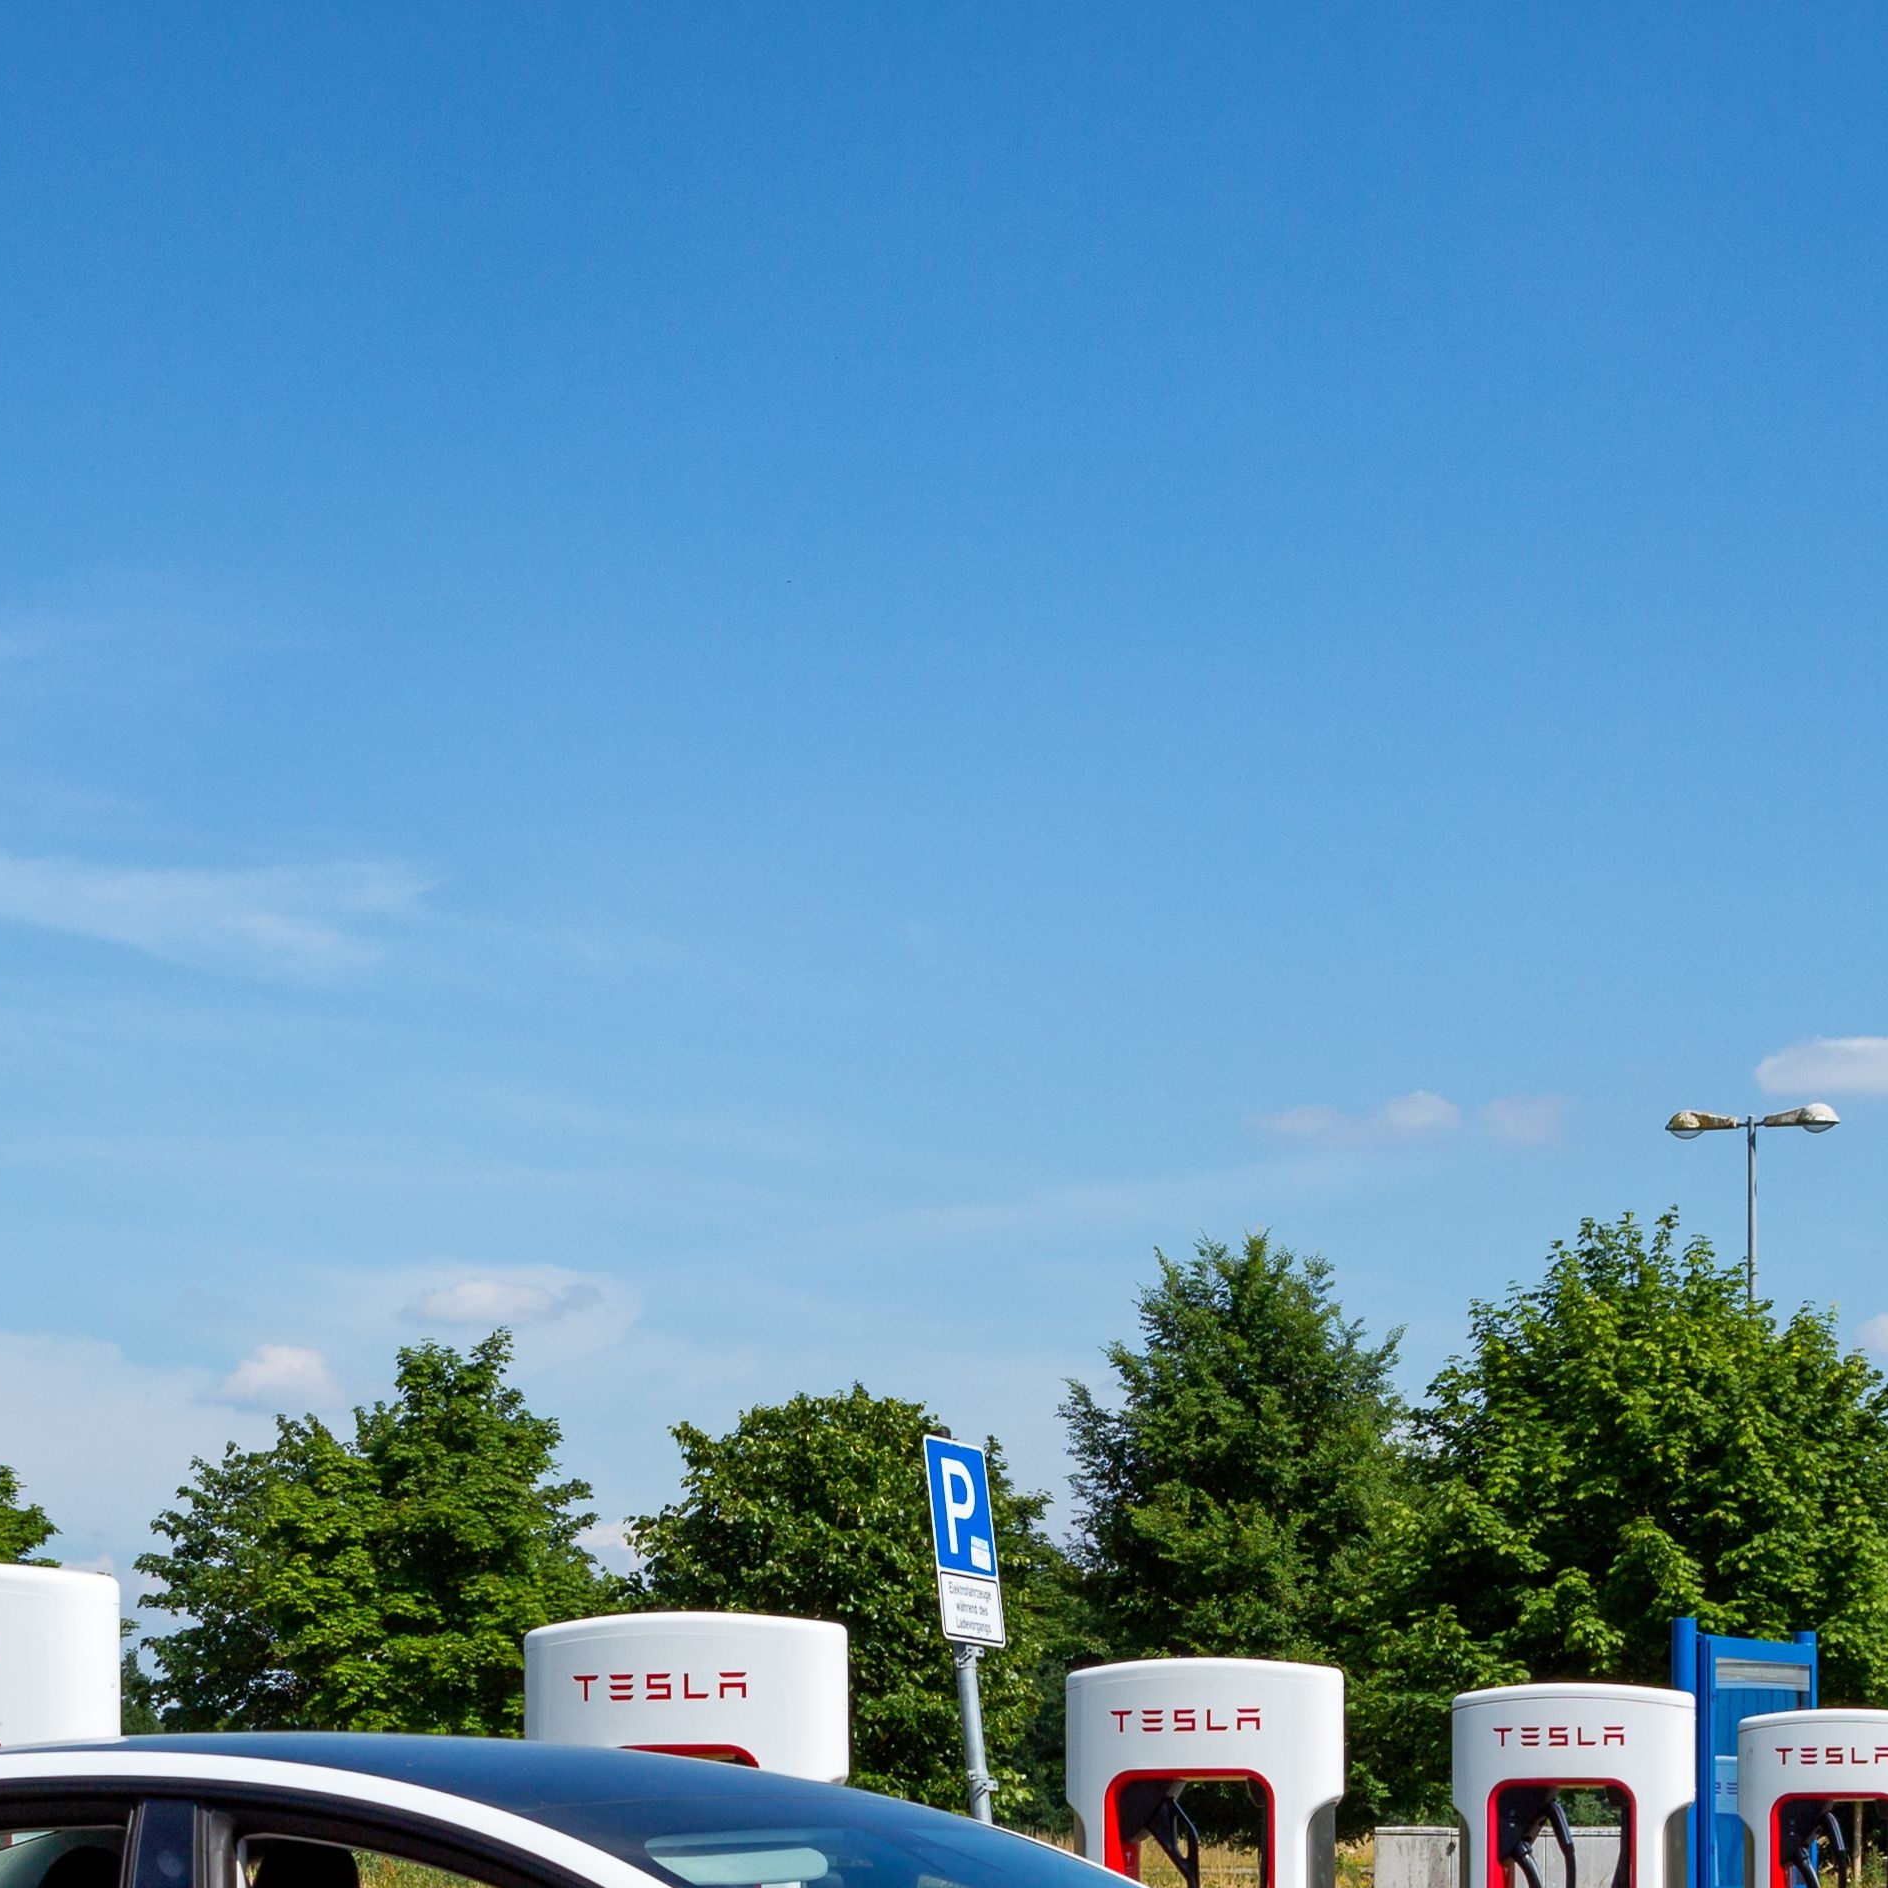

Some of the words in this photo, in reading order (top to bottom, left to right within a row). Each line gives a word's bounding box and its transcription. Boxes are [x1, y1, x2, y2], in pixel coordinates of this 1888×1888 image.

[941, 1457, 975, 1554] P
[574, 1671, 747, 1701] TESLA
[1111, 1708, 1261, 1733] TESLA
[1494, 1725, 1625, 1747] TESLA
